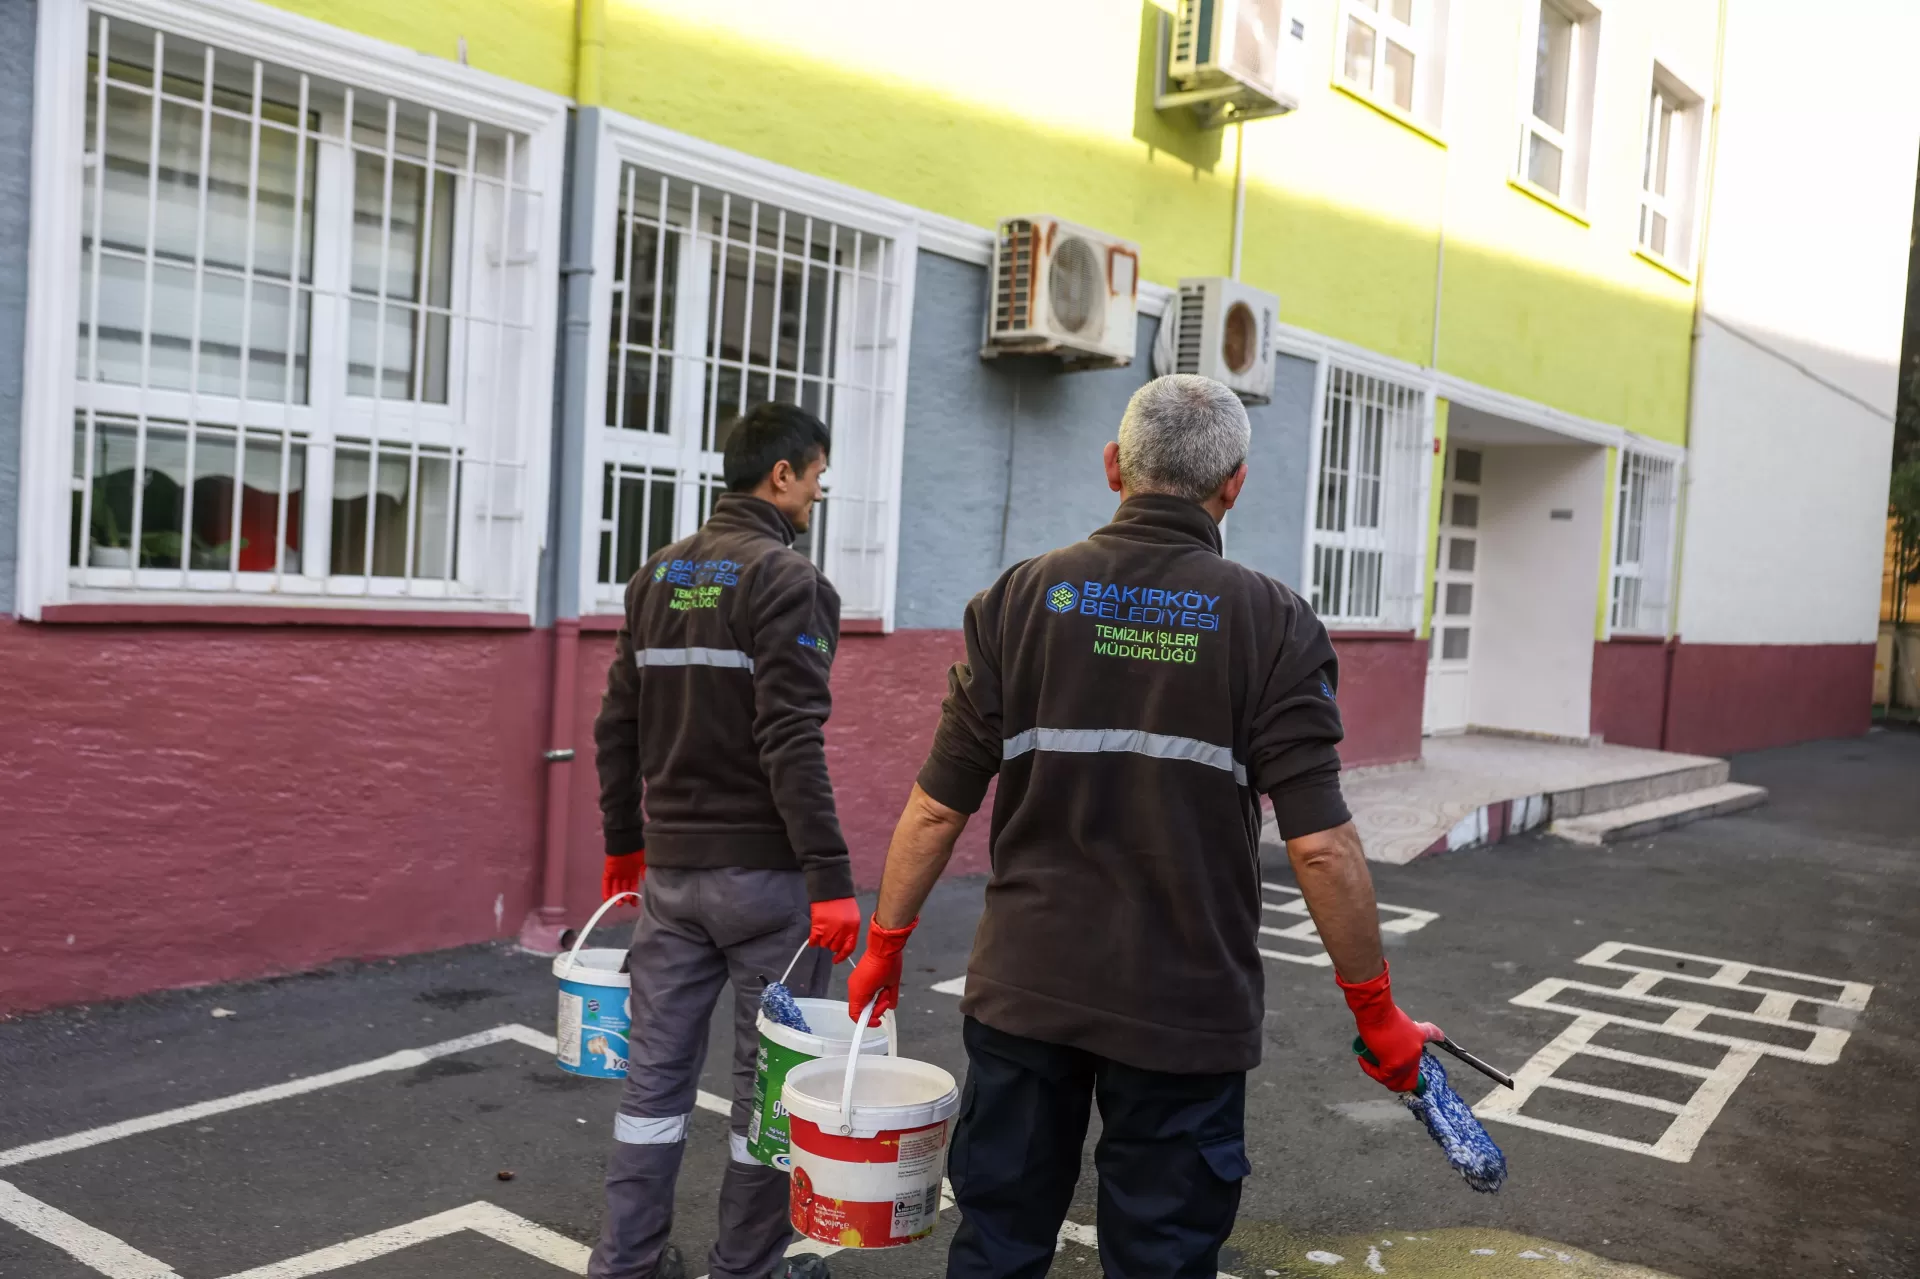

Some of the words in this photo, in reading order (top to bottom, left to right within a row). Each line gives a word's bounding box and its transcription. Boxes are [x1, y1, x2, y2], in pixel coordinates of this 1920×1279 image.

[1083, 580, 1220, 612] BAKIRKÖY
[1095, 624, 1154, 644] TEMİZLİK
[1156, 629, 1199, 648] İŞLERİ
[1093, 640, 1197, 663] MÜDÜRLÜĞÜ
